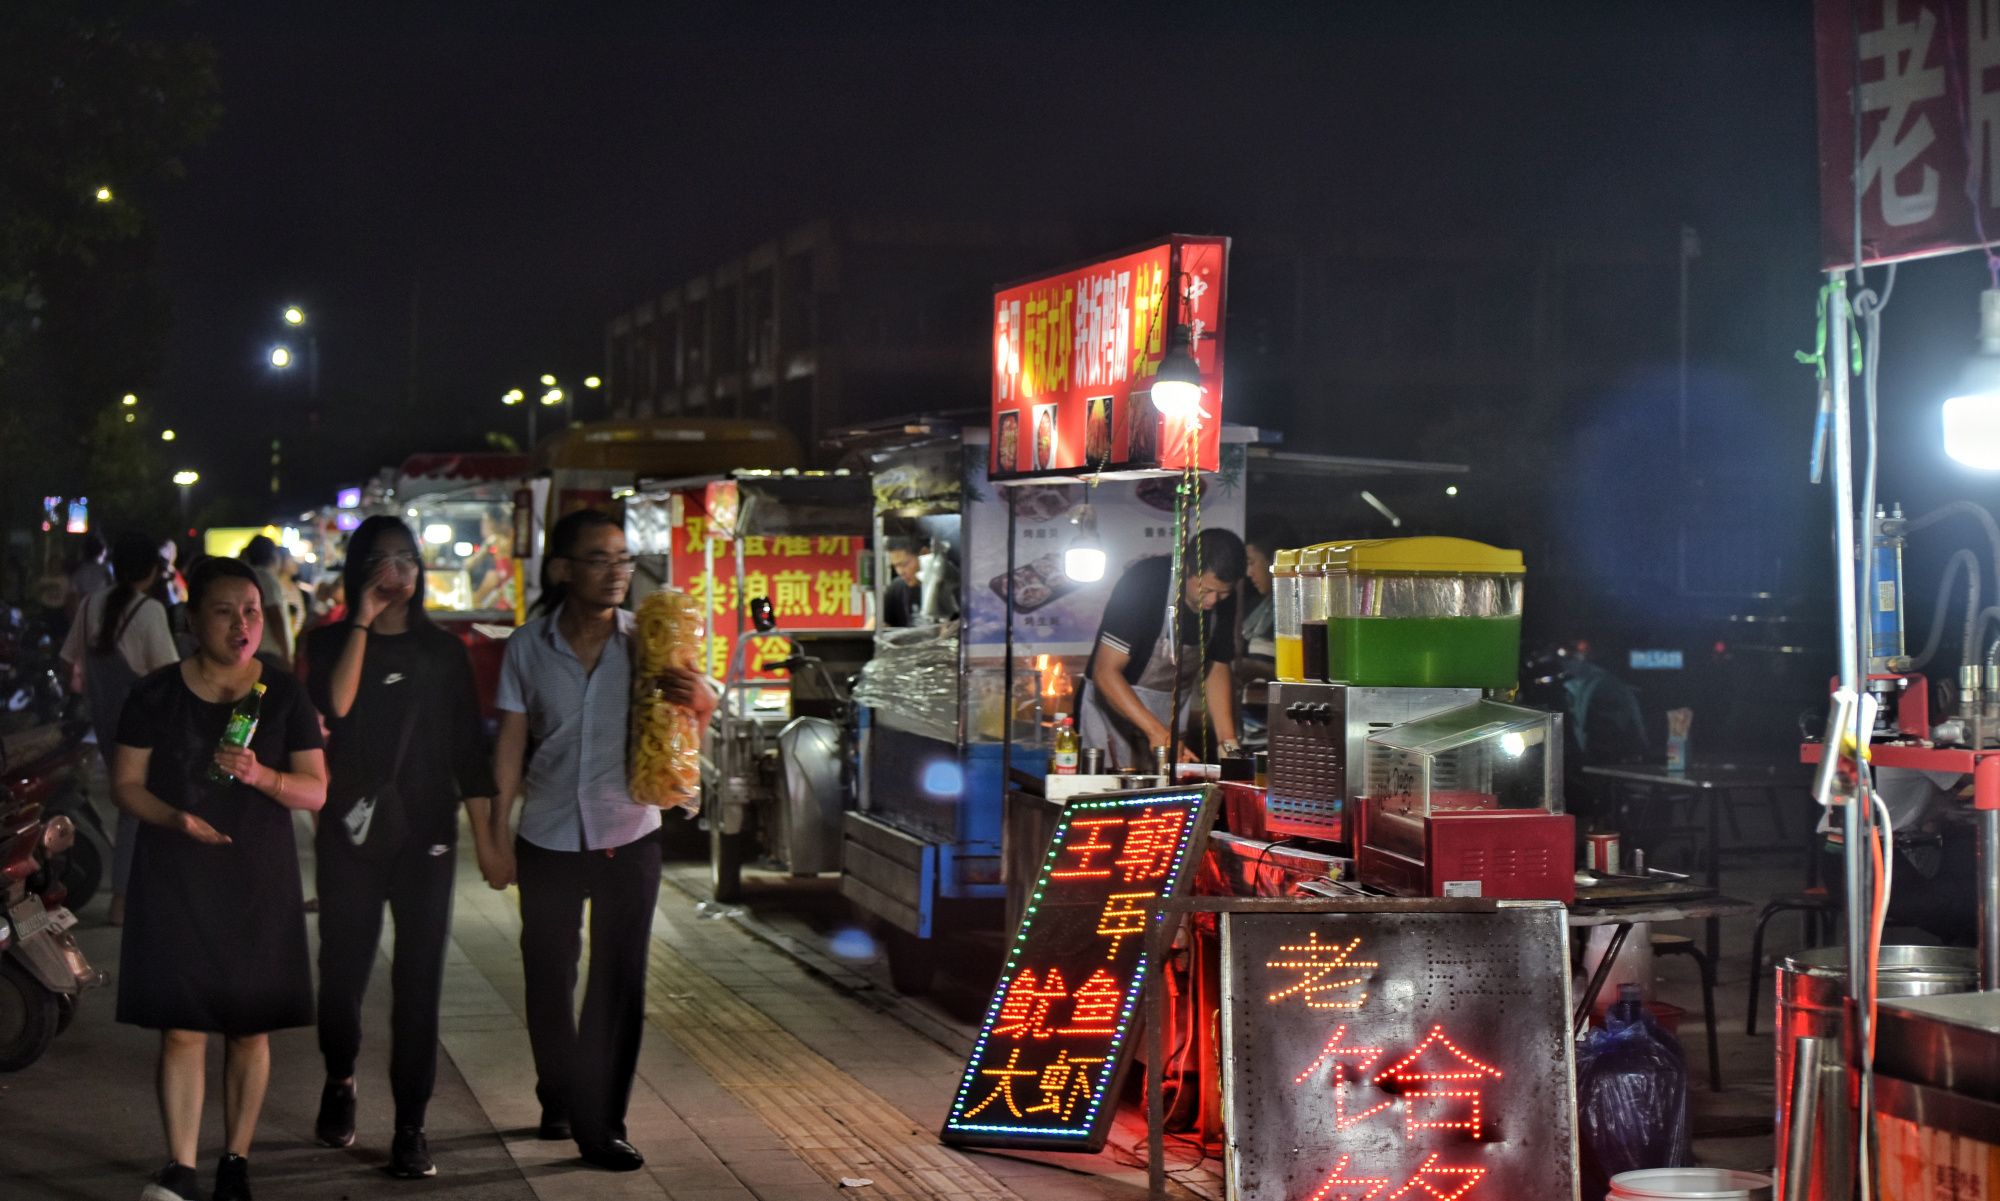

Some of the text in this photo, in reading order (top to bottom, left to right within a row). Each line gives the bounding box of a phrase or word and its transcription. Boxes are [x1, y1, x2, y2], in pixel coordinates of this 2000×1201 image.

[688, 569, 854, 617] 杂粮煎饼
[1050, 807, 1184, 882] 王朝
[992, 967, 1121, 1040] 鱿鱼
[963, 1047, 1107, 1121] 大虾
